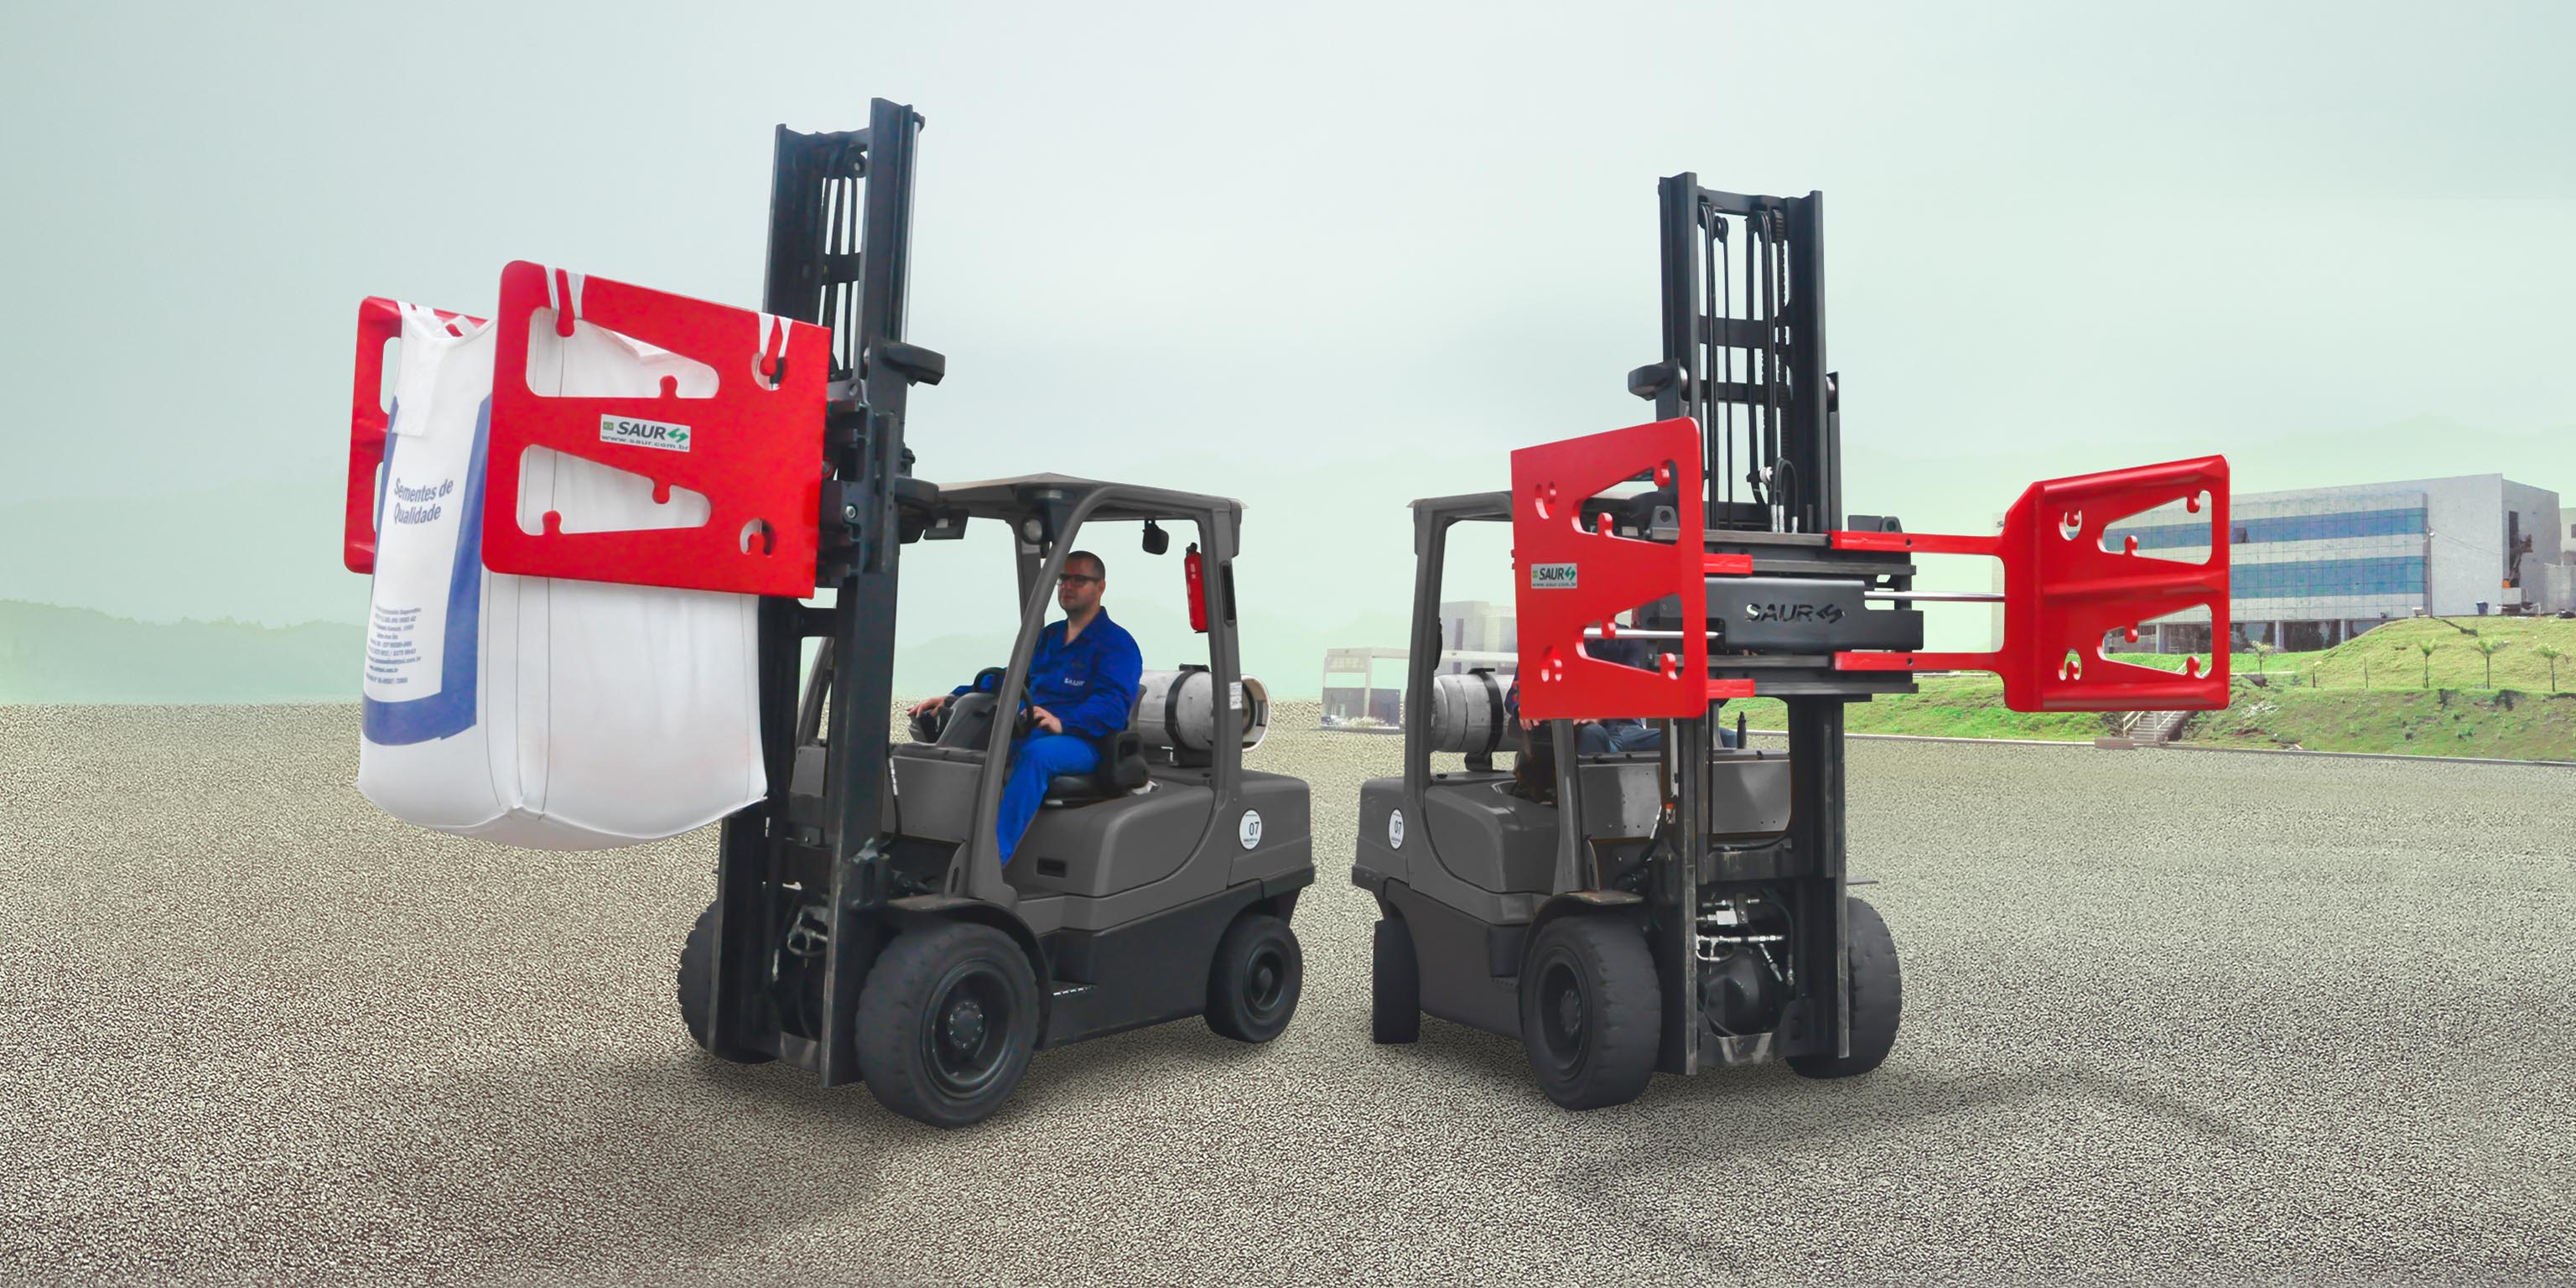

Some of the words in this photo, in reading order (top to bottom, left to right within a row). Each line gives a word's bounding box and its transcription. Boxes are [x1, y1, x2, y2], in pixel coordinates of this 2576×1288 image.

[616, 421, 667, 440] SAUR
[601, 435, 688, 450] www.saur.com.br
[394, 477, 438, 502] Sementes
[439, 478, 454, 497] de
[394, 502, 442, 525] Qualidade
[1539, 567, 1565, 580] SAUR
[1745, 603, 1814, 622] SAUR
[1249, 820, 1260, 836] 07
[1394, 819, 1402, 835] 07
